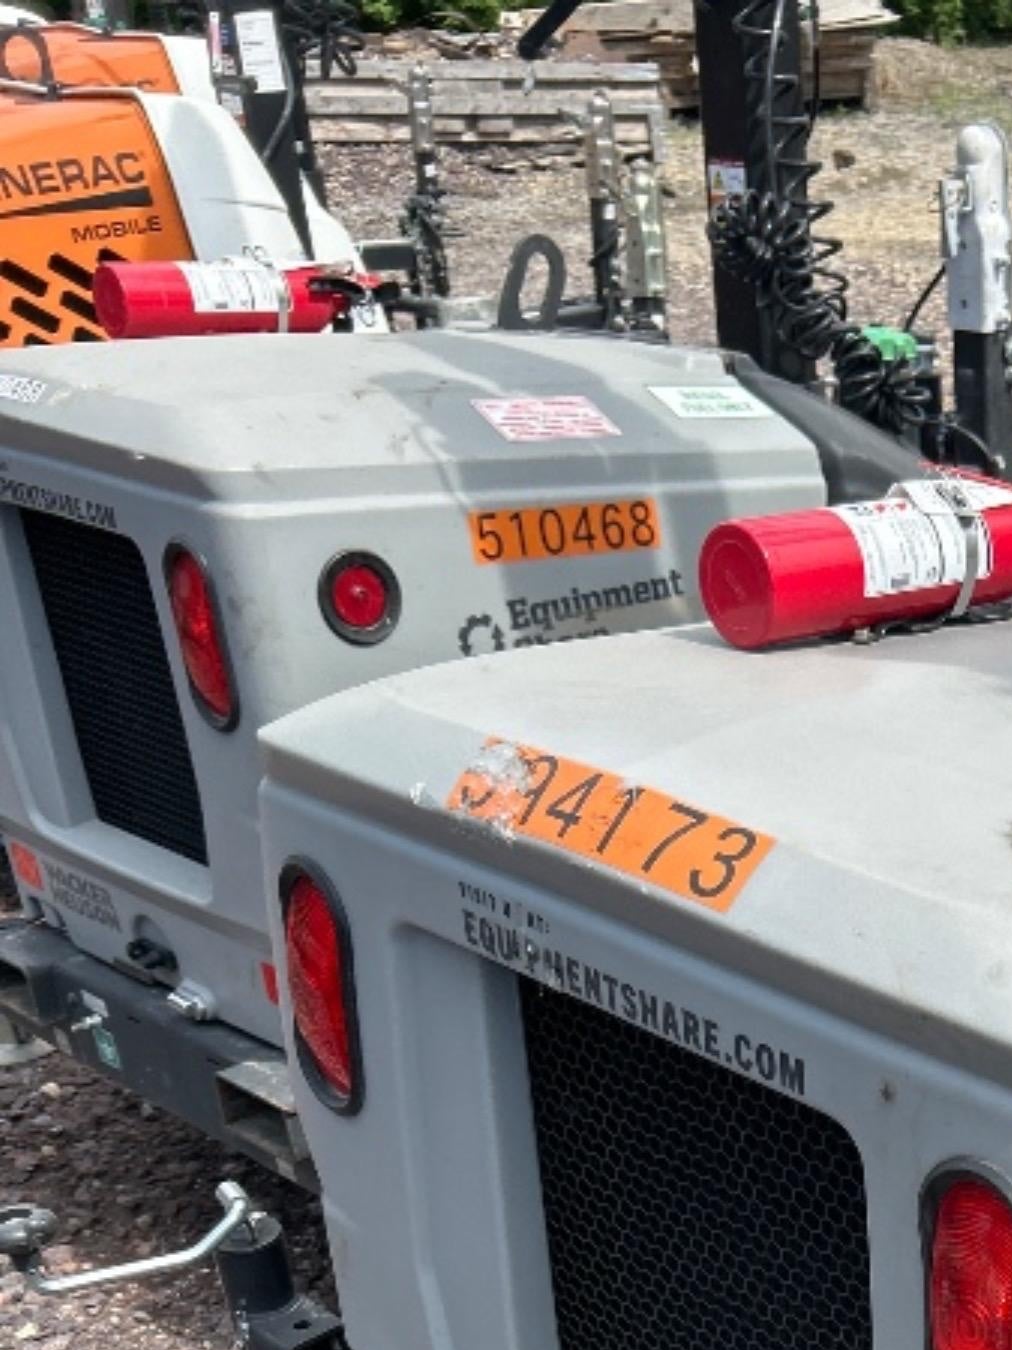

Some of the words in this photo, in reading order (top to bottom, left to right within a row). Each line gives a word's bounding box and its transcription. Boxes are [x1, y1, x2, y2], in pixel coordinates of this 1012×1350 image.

[71, 215, 162, 243] MOBILE
[477, 501, 655, 561] 510468
[507, 569, 685, 631] Equipment
